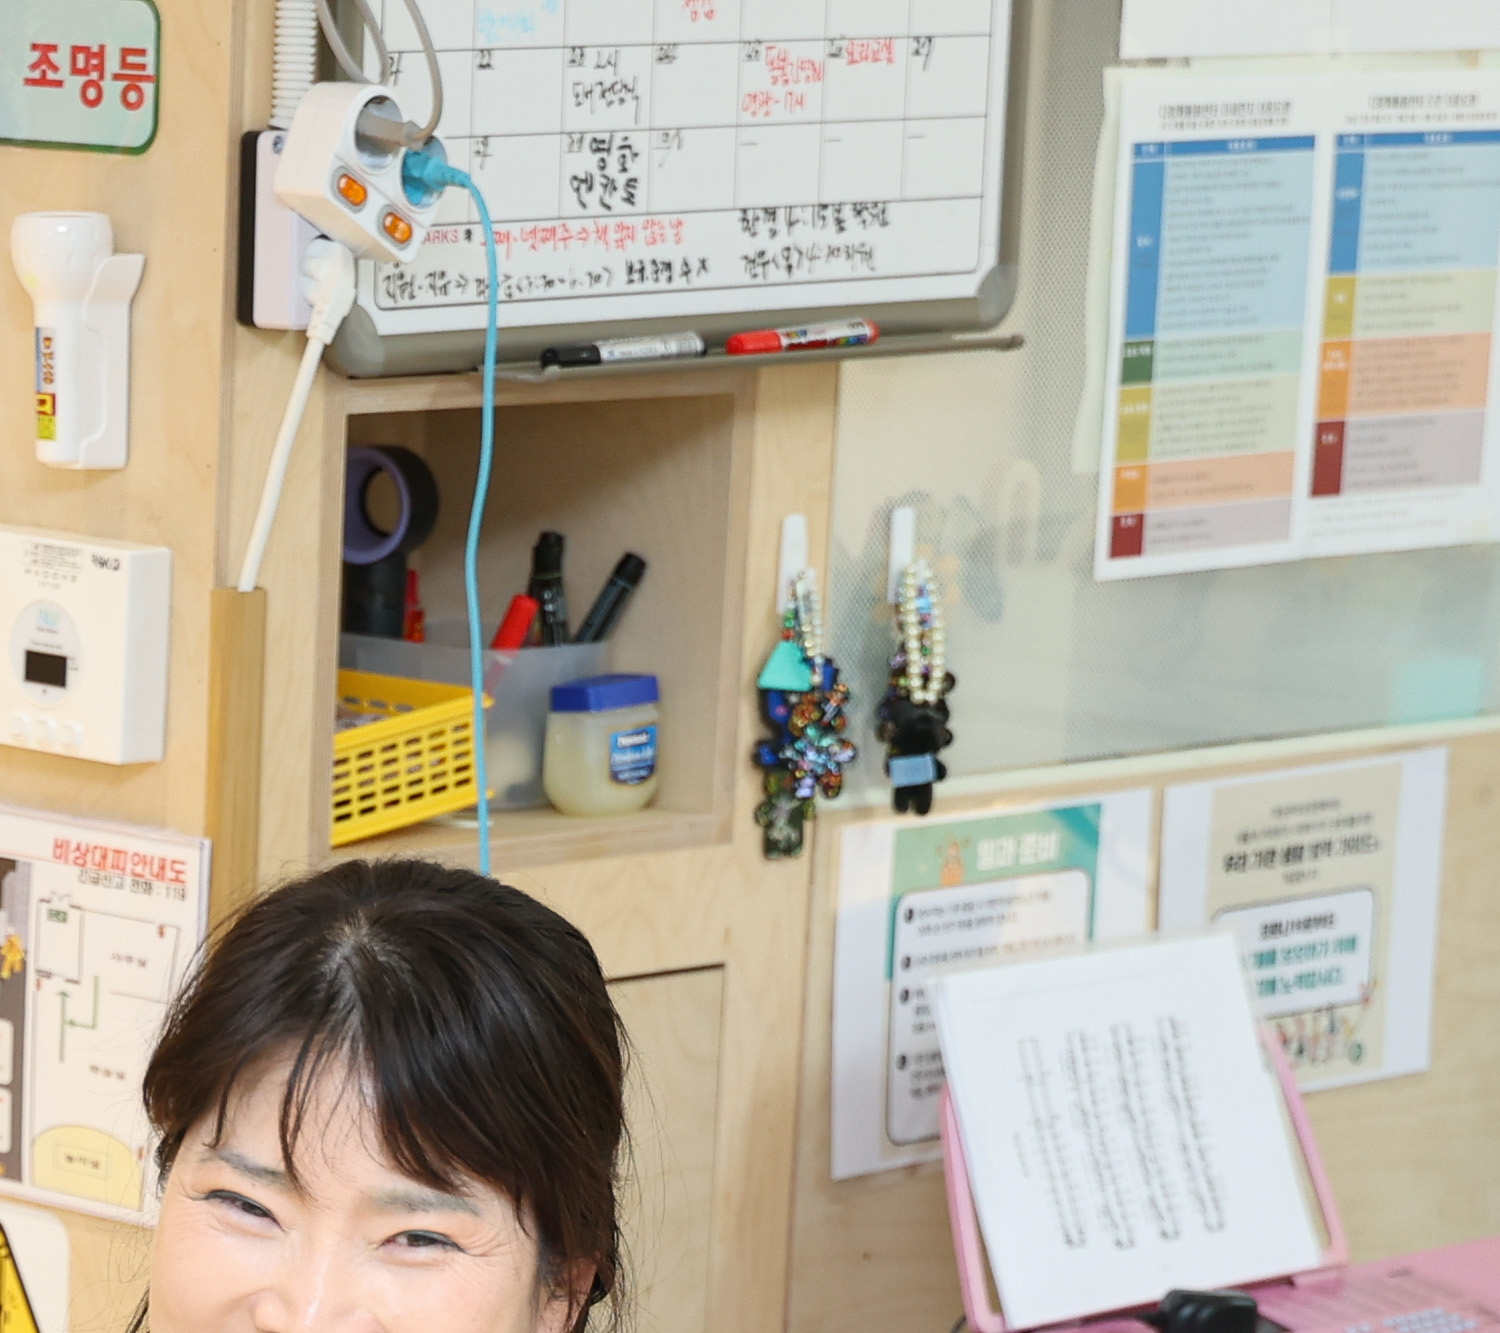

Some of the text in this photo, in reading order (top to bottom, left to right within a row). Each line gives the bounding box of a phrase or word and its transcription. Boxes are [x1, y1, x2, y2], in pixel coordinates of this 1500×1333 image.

[23, 42, 157, 111] 조명등
[424, 228, 459, 244] ARKS
[53, 838, 187, 885] 비상대피안내도
